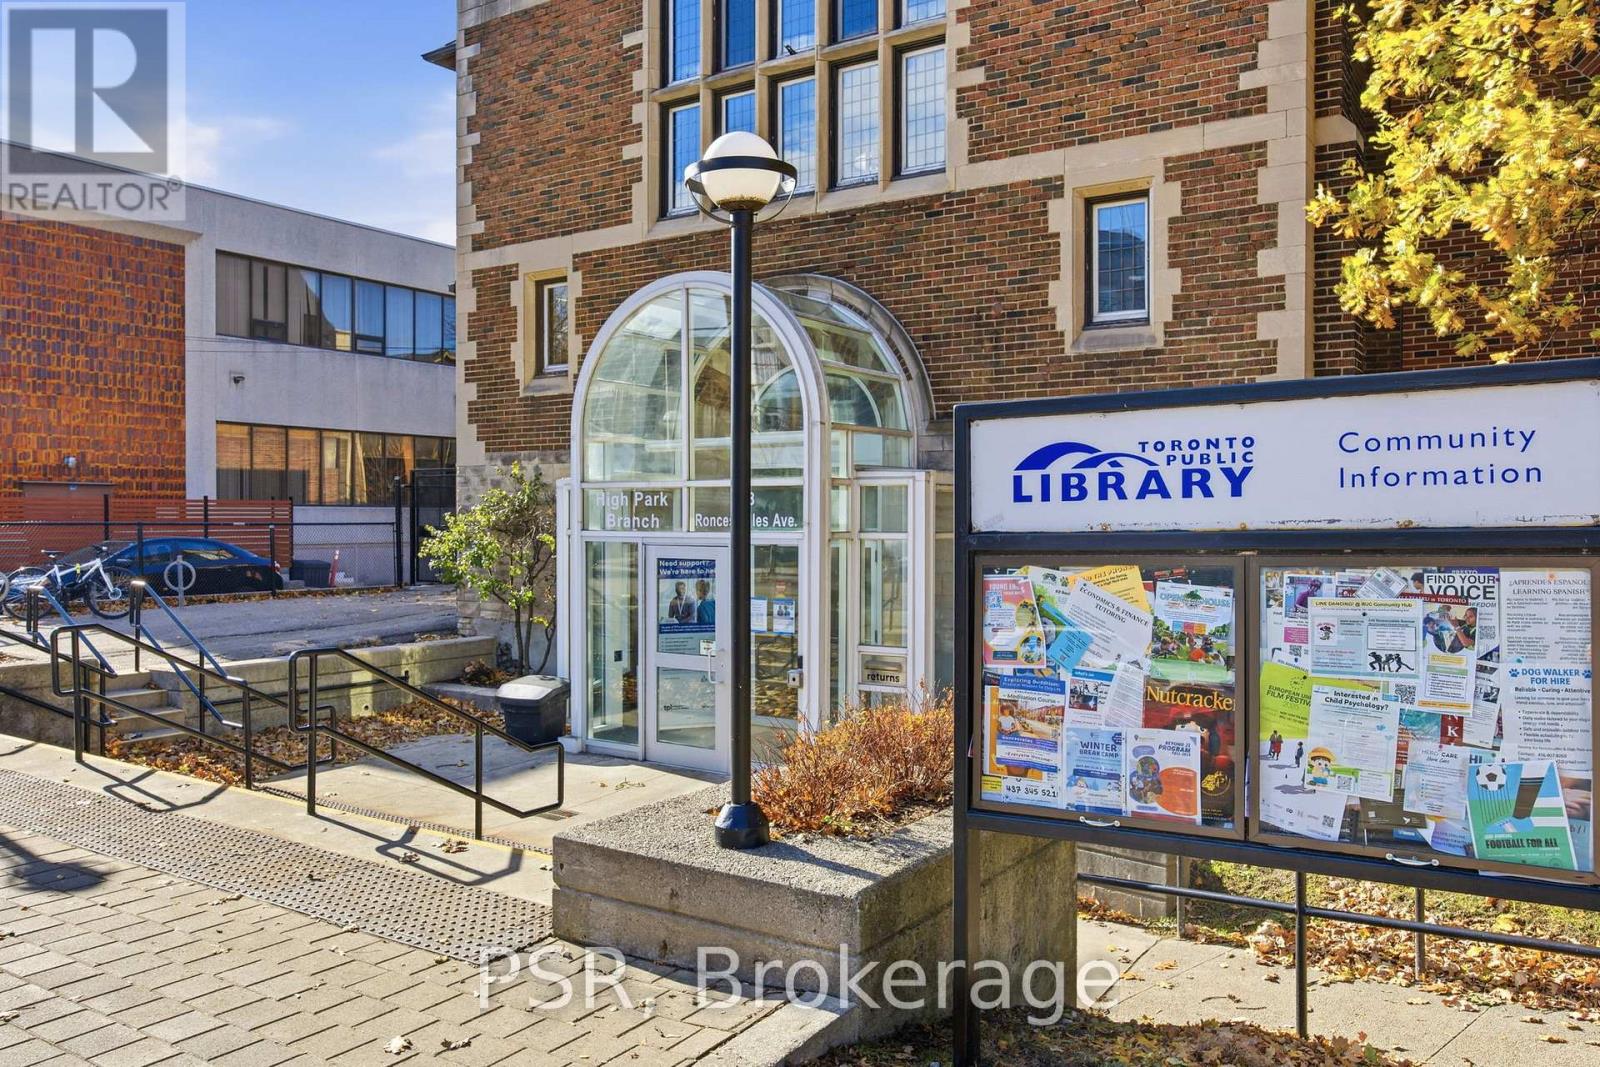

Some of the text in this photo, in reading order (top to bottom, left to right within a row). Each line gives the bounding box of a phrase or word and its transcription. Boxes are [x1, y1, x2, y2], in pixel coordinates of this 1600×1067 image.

[1138, 436, 1256, 453] TORONTO
[1338, 426, 1536, 453] Community
[1166, 451, 1254, 466] PUBLIC
[1339, 463, 1542, 488] Information
[1013, 466, 1254, 503] LIBRARY
[596, 491, 668, 510] High Park
[607, 513, 660, 528] Branch
[695, 513, 798, 528] Ronceles Ave.
[1426, 575, 1496, 585] FIND YOUR
[1428, 585, 1496, 600] VOICE
[1079, 586, 1116, 609] ECONOMICS
[1121, 608, 1149, 626] FINANCE
[1095, 603, 1126, 624] TUTORING
[867, 672, 900, 683] returns
[1521, 668, 1580, 677] DOG WALKER
[1530, 677, 1571, 685] FOR HIRE
[1268, 685, 1300, 697] EUROPEAN
[1334, 691, 1371, 700] Interested
[1266, 690, 1312, 707] FILM FESTIV
[1344, 699, 1389, 710] Psychology?
[1447, 725, 1459, 737] K
[1080, 741, 1117, 752] WINTER
[1158, 744, 1191, 753] PROGRAM
[1080, 749, 1119, 759] BREAK CAMP
[1006, 784, 1021, 794] 437
[1025, 786, 1039, 796] 345
[1485, 838, 1559, 849] FOOTBALL FOR ALL
